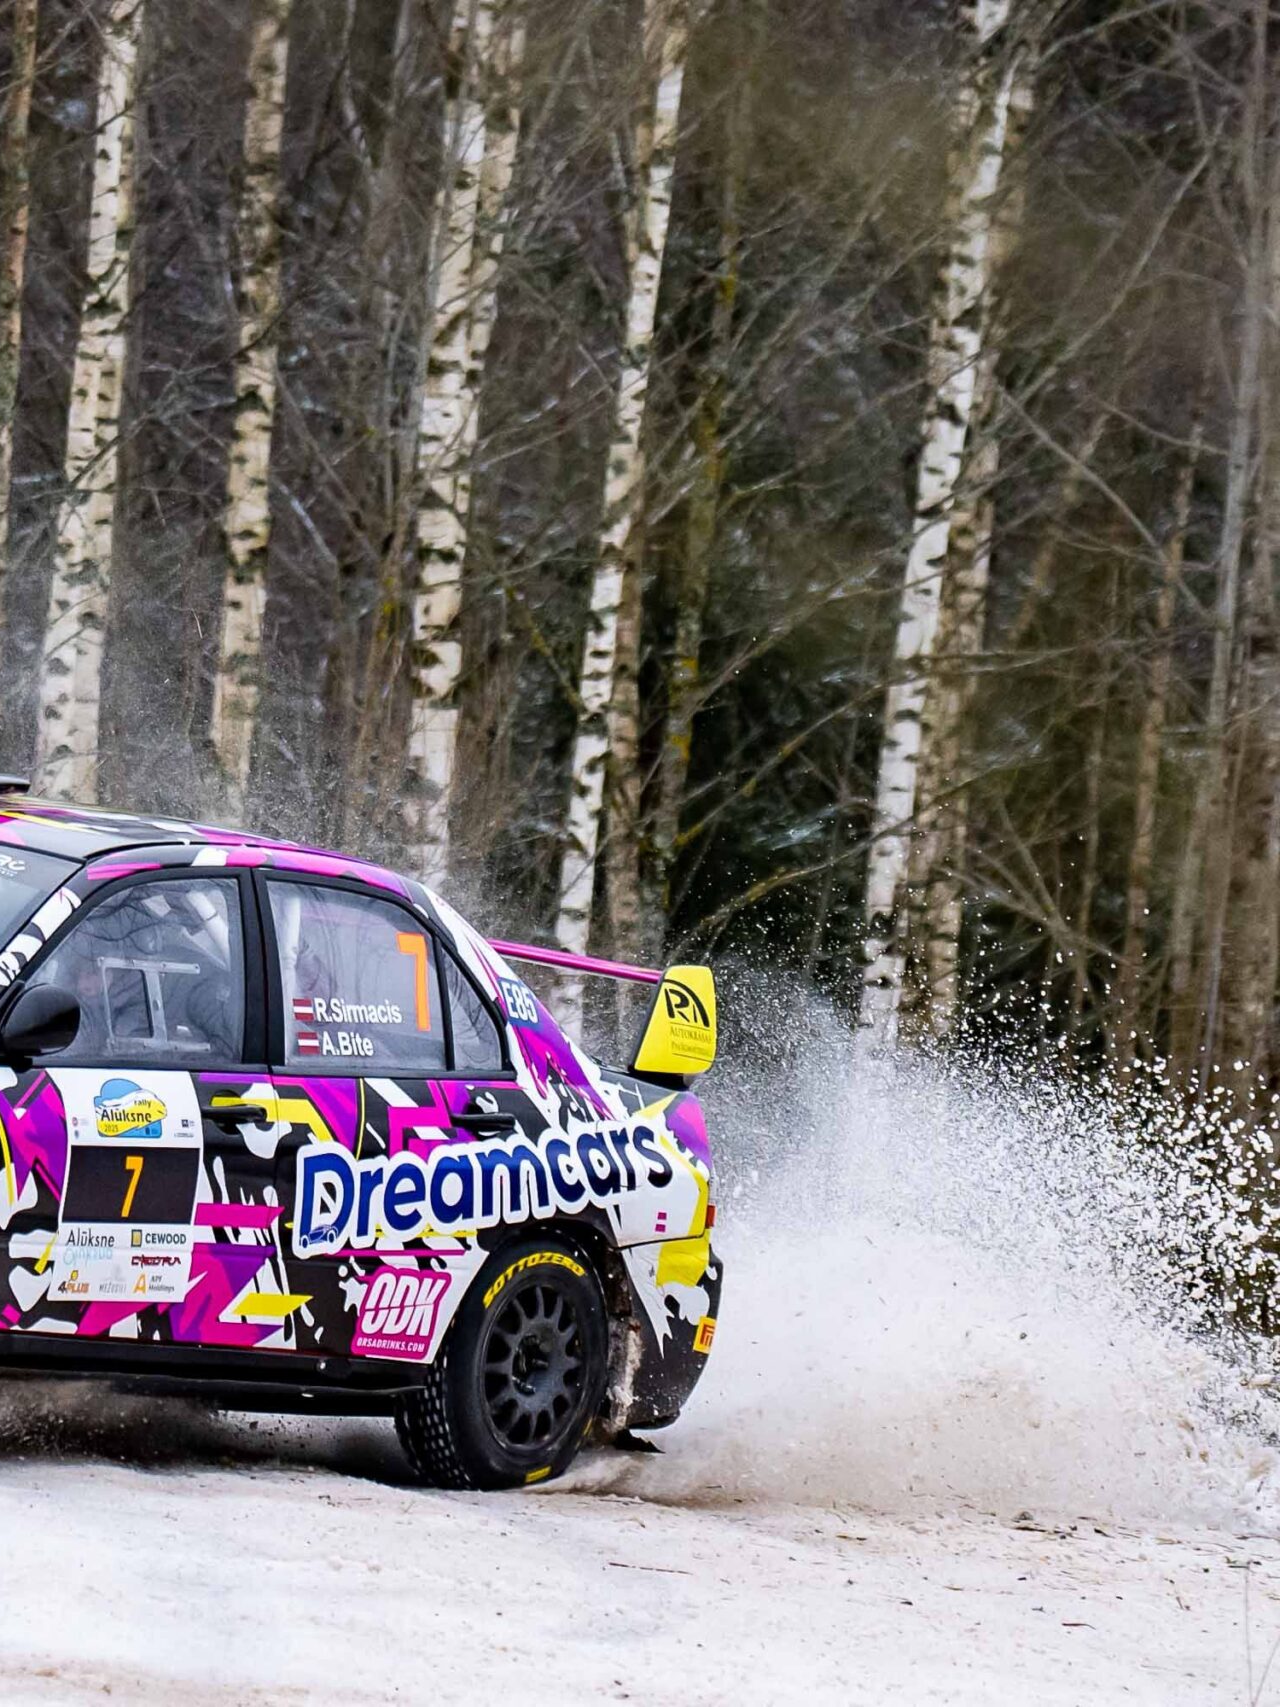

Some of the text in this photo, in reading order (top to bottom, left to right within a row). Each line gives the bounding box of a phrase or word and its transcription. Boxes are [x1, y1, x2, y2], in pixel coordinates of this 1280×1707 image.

[315, 998, 402, 1024] R.Sirmacis
[502, 981, 539, 1024] E85
[322, 1032, 374, 1056] A.Bite
[100, 1108, 152, 1123] Alūksne
[133, 1099, 152, 1109] rally
[121, 1156, 144, 1218] 7
[298, 1125, 673, 1249] Dreamcars
[65, 1228, 115, 1247] Alūksne
[145, 1233, 187, 1245] CEWOOD
[483, 1252, 587, 1309] SOTTOZERO
[361, 1272, 447, 1337] ODK
